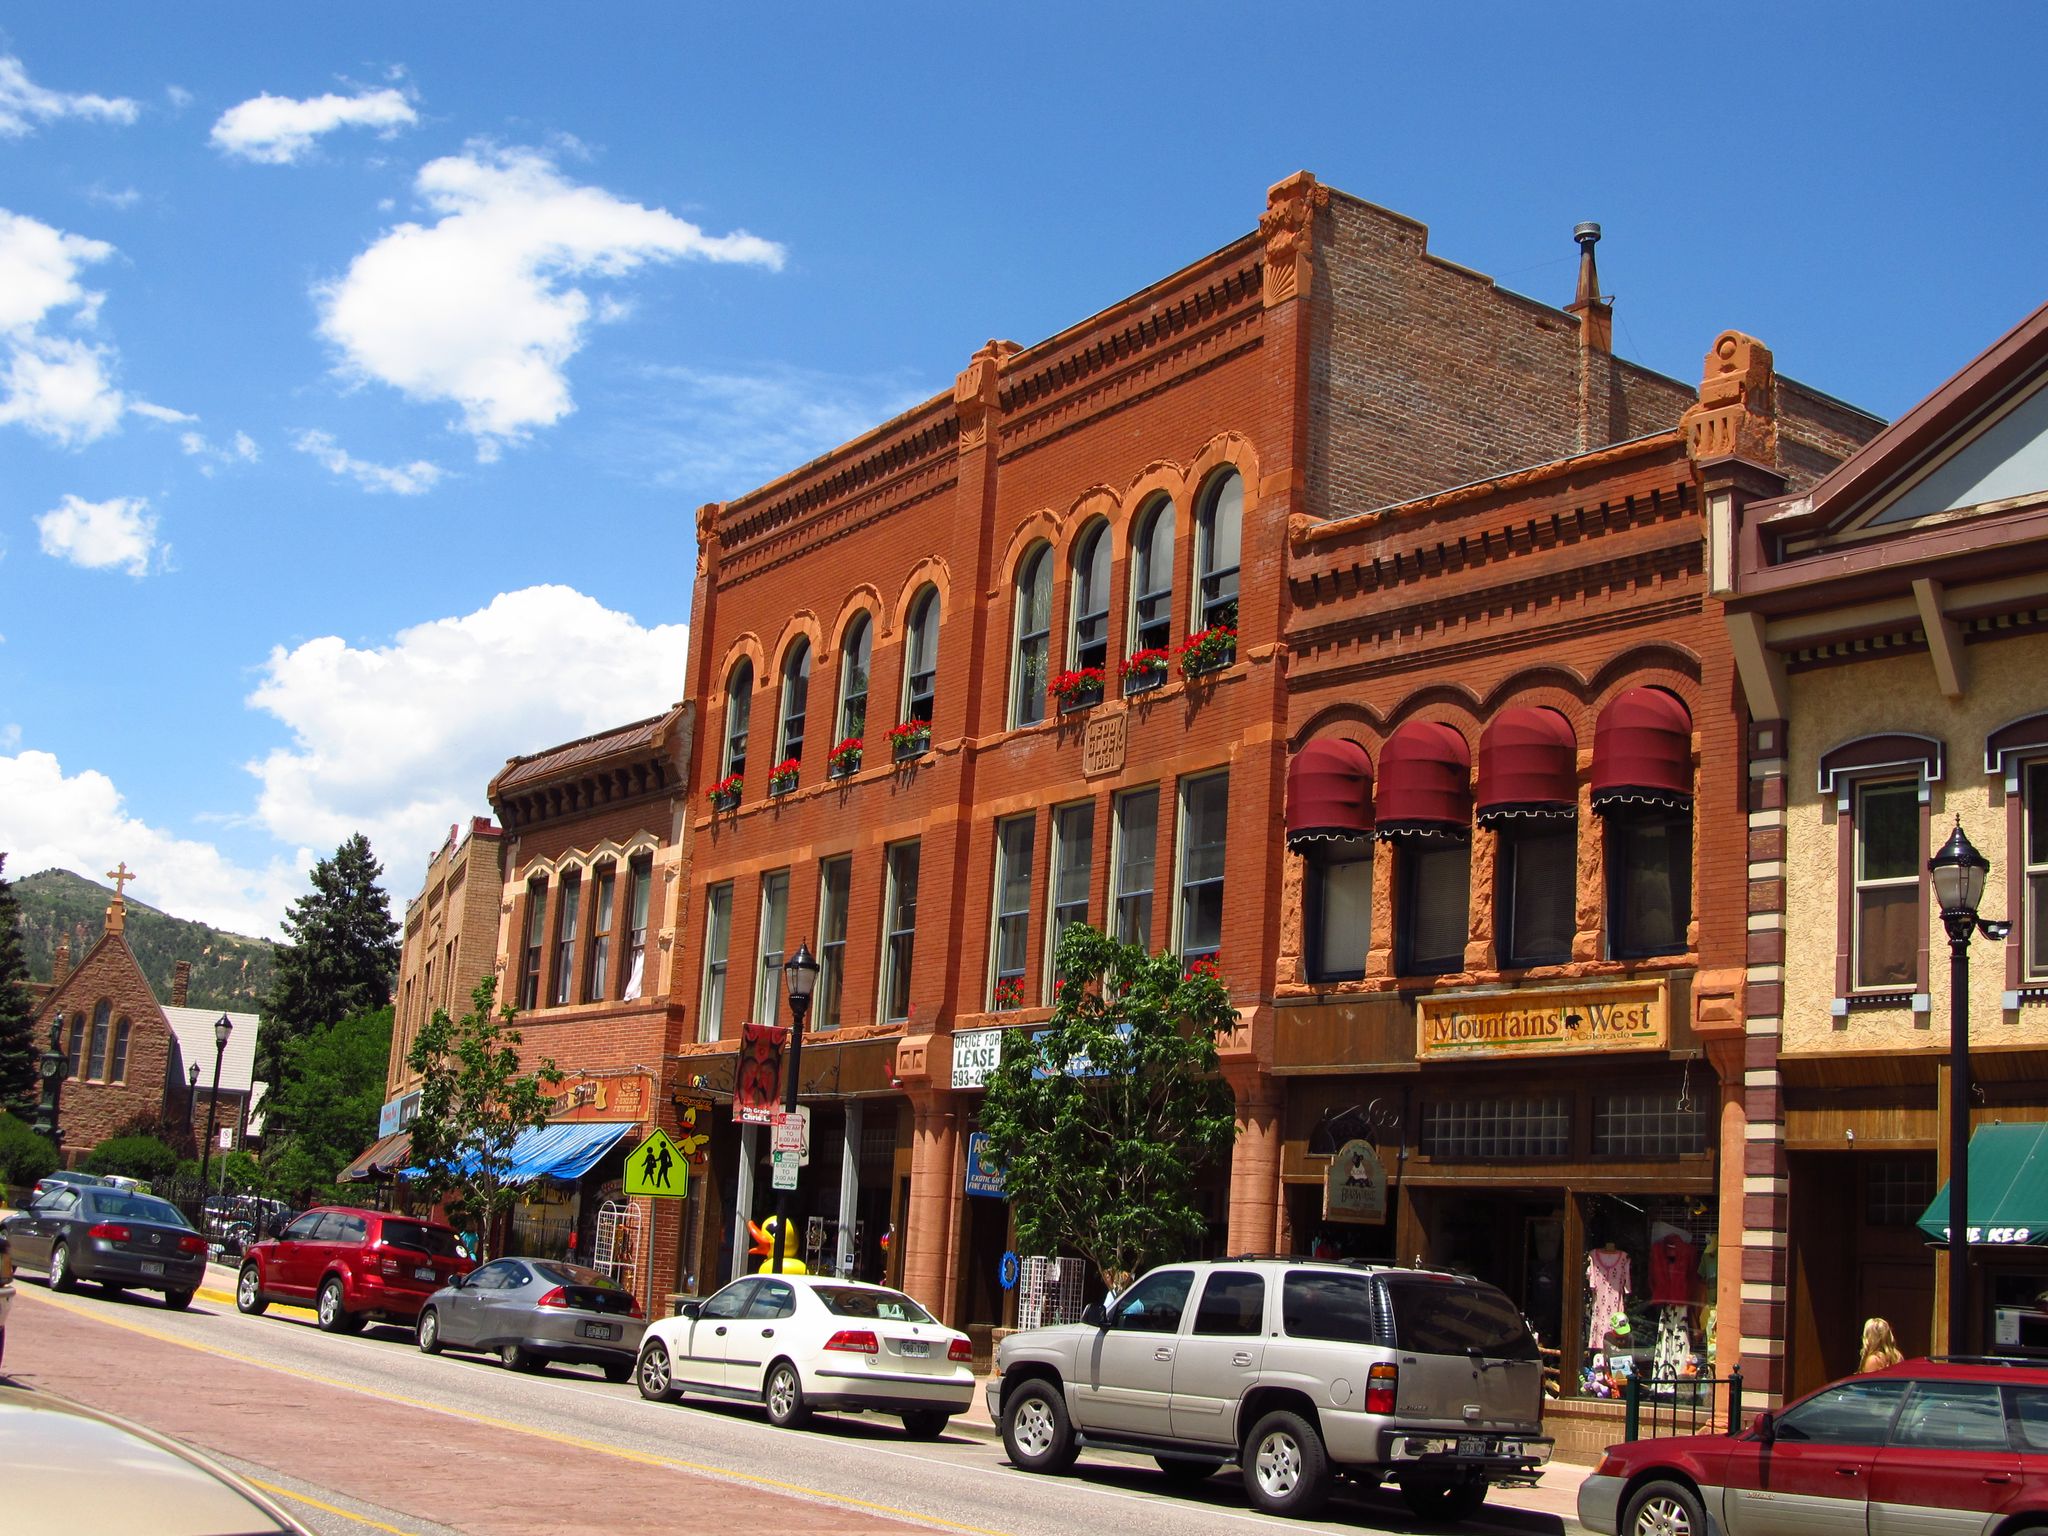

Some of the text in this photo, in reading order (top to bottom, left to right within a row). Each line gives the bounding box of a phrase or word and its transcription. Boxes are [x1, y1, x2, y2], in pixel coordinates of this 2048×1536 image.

[1432, 1003, 1650, 1041] Mountains West
[954, 1032, 1000, 1049] OFFICE FOR
[1564, 1031, 1631, 1042] of Colorado
[956, 1048, 995, 1068] LEASE
[742, 1113, 762, 1121] Chris
[776, 1153, 782, 1162] 3
[971, 1174, 991, 1183] EXOTIC
[1987, 1227, 2030, 1243] KEG
